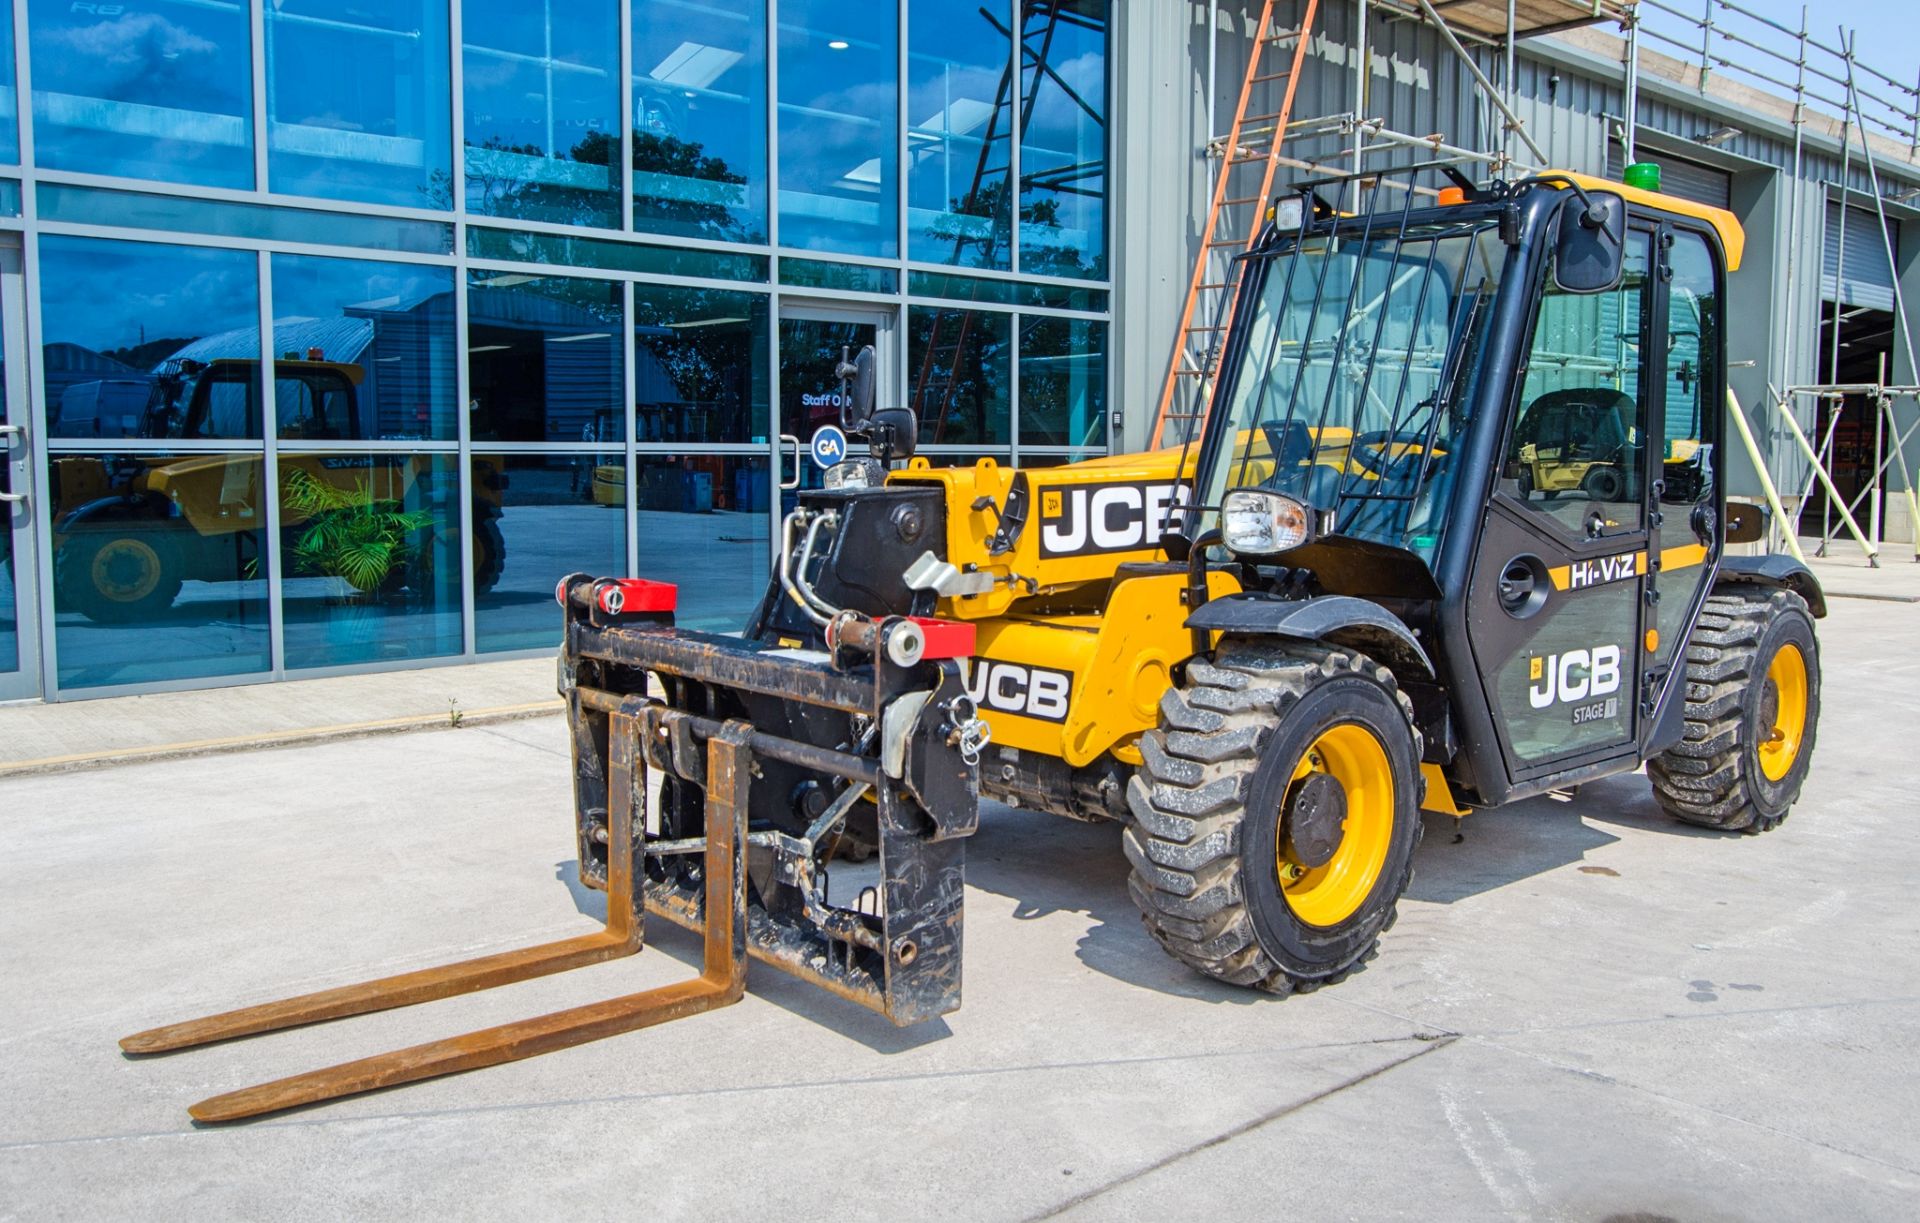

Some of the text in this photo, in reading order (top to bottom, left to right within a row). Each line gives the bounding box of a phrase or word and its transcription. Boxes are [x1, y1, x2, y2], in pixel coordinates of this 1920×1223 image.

[802, 393, 830, 406] Staff
[1043, 484, 1192, 553] JCB
[1529, 645, 1620, 708] JCB
[1573, 702, 1604, 723] STAGE
